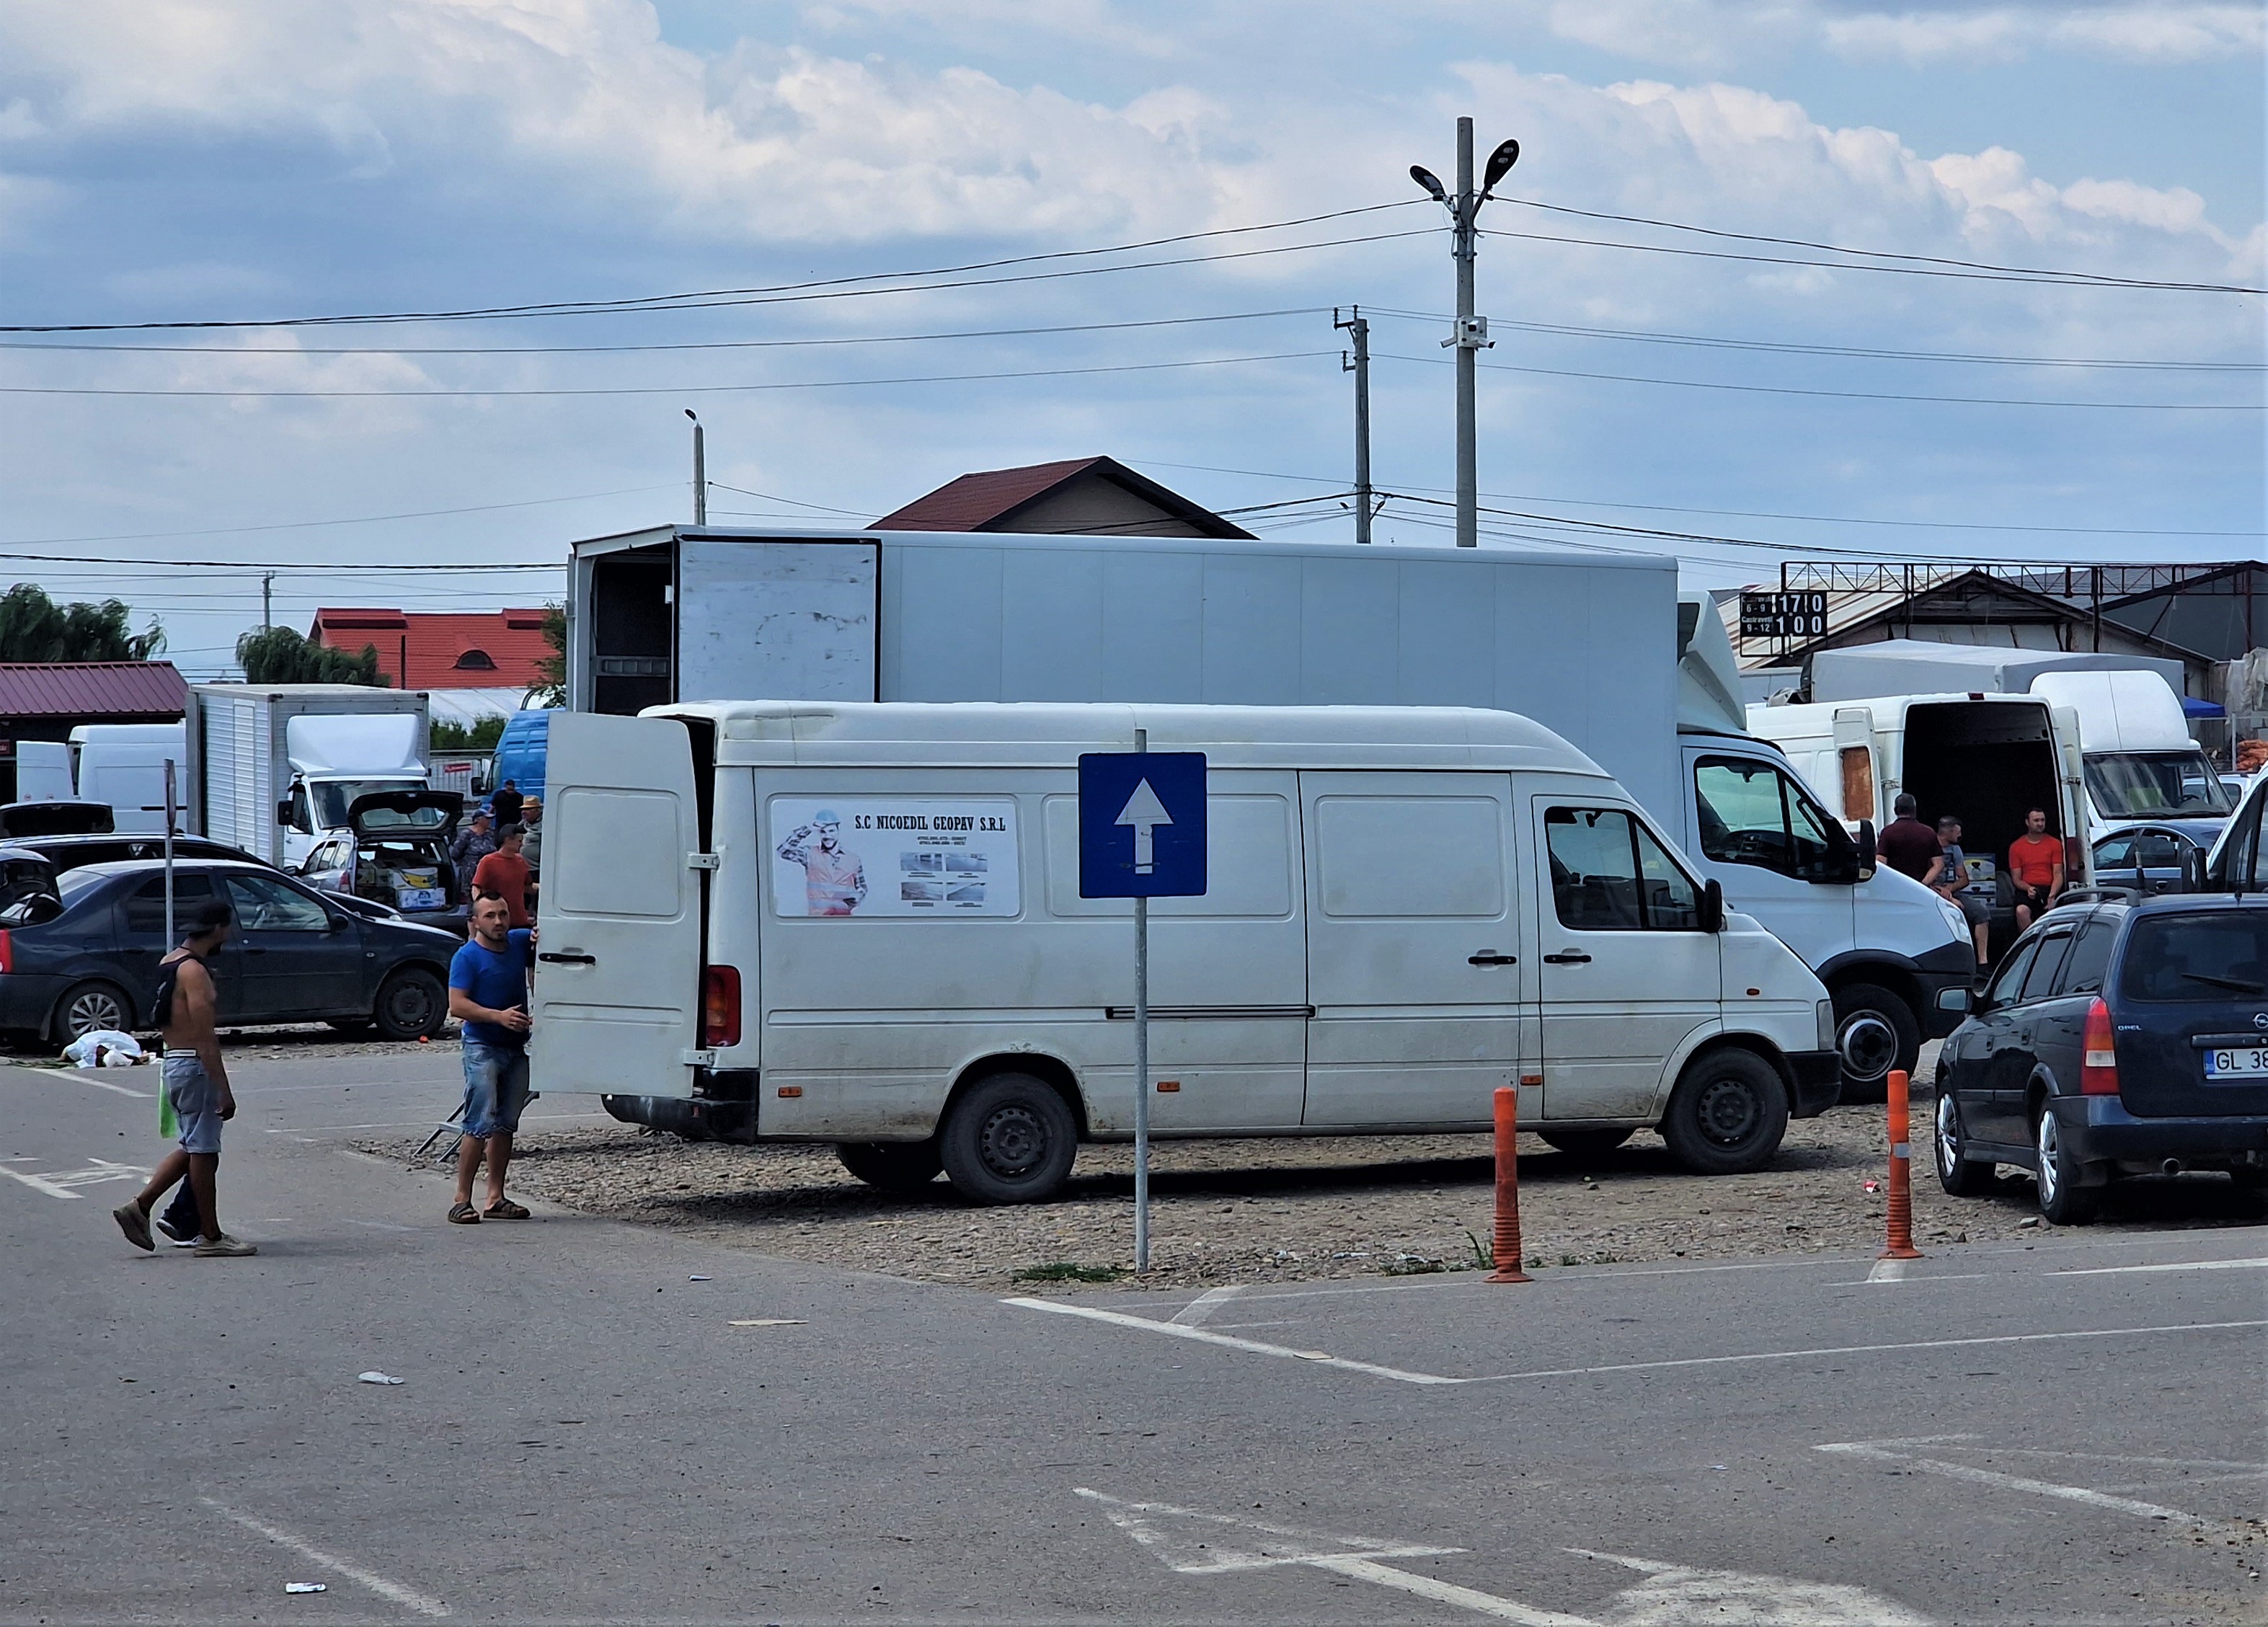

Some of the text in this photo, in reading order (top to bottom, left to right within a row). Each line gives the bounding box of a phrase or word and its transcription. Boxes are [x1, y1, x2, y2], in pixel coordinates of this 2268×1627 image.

[1760, 624, 1770, 632] 12
[855, 815, 1006, 831] S.C NICOEDIL GEOPAV S.R.L
[2216, 1051, 2243, 1070] GL
